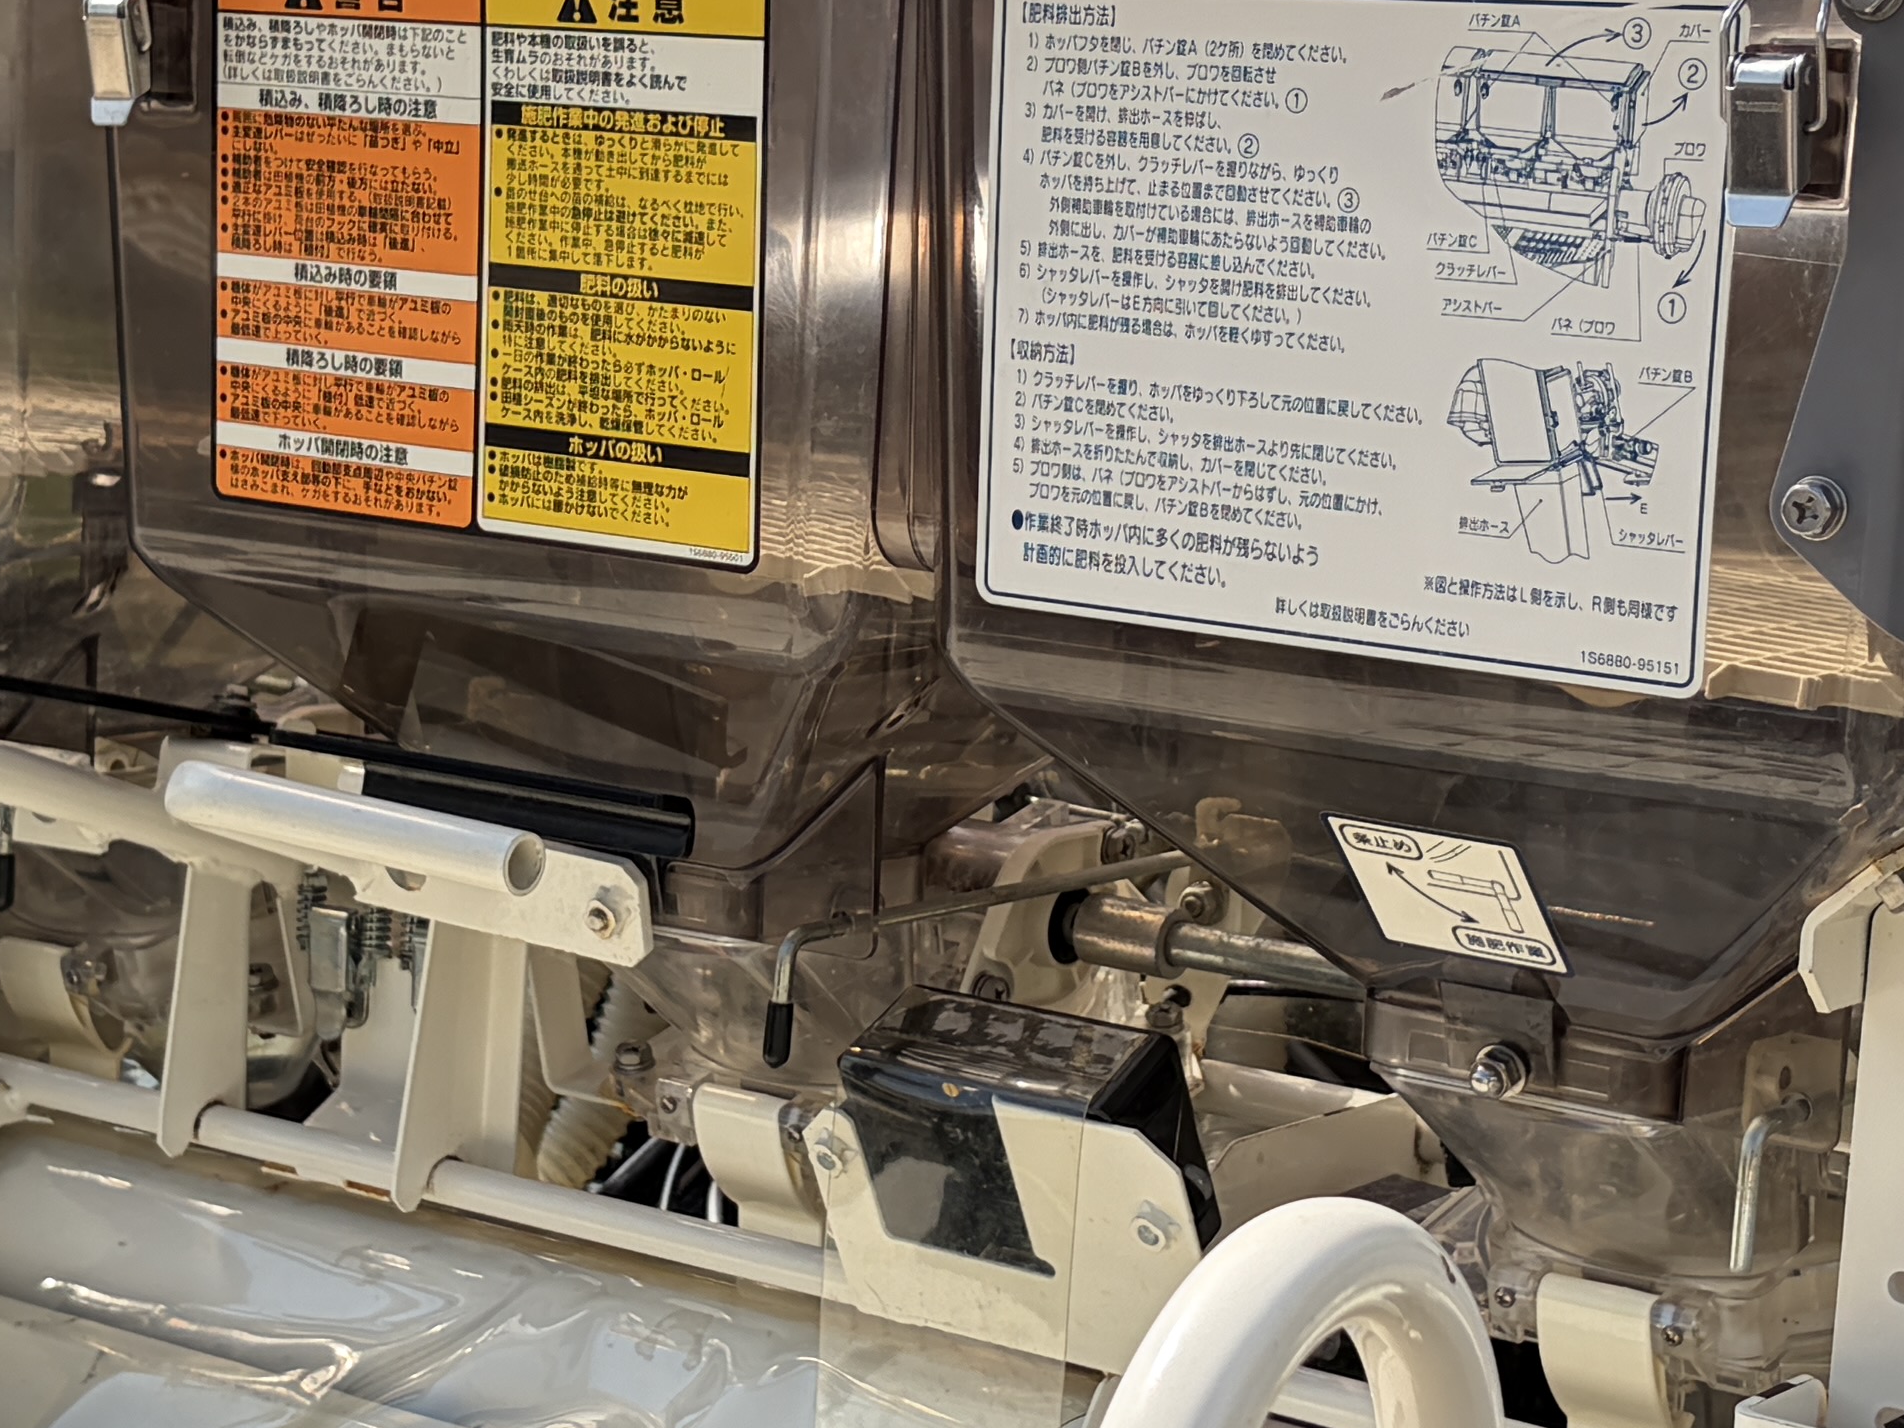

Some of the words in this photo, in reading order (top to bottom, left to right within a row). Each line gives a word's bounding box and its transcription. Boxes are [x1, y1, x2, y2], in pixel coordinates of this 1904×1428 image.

[1679, 23, 1711, 38] カバー
[1673, 141, 1706, 156] ブロワ
[1435, 261, 1506, 279] クラッチレバー
[579, 274, 658, 299] 肥料の扱い
[1442, 297, 1502, 315] アシストバー
[1009, 337, 1077, 365] 【収納方法】
[1639, 502, 1647, 514] E
[1618, 528, 1684, 549] シャッタレバー
